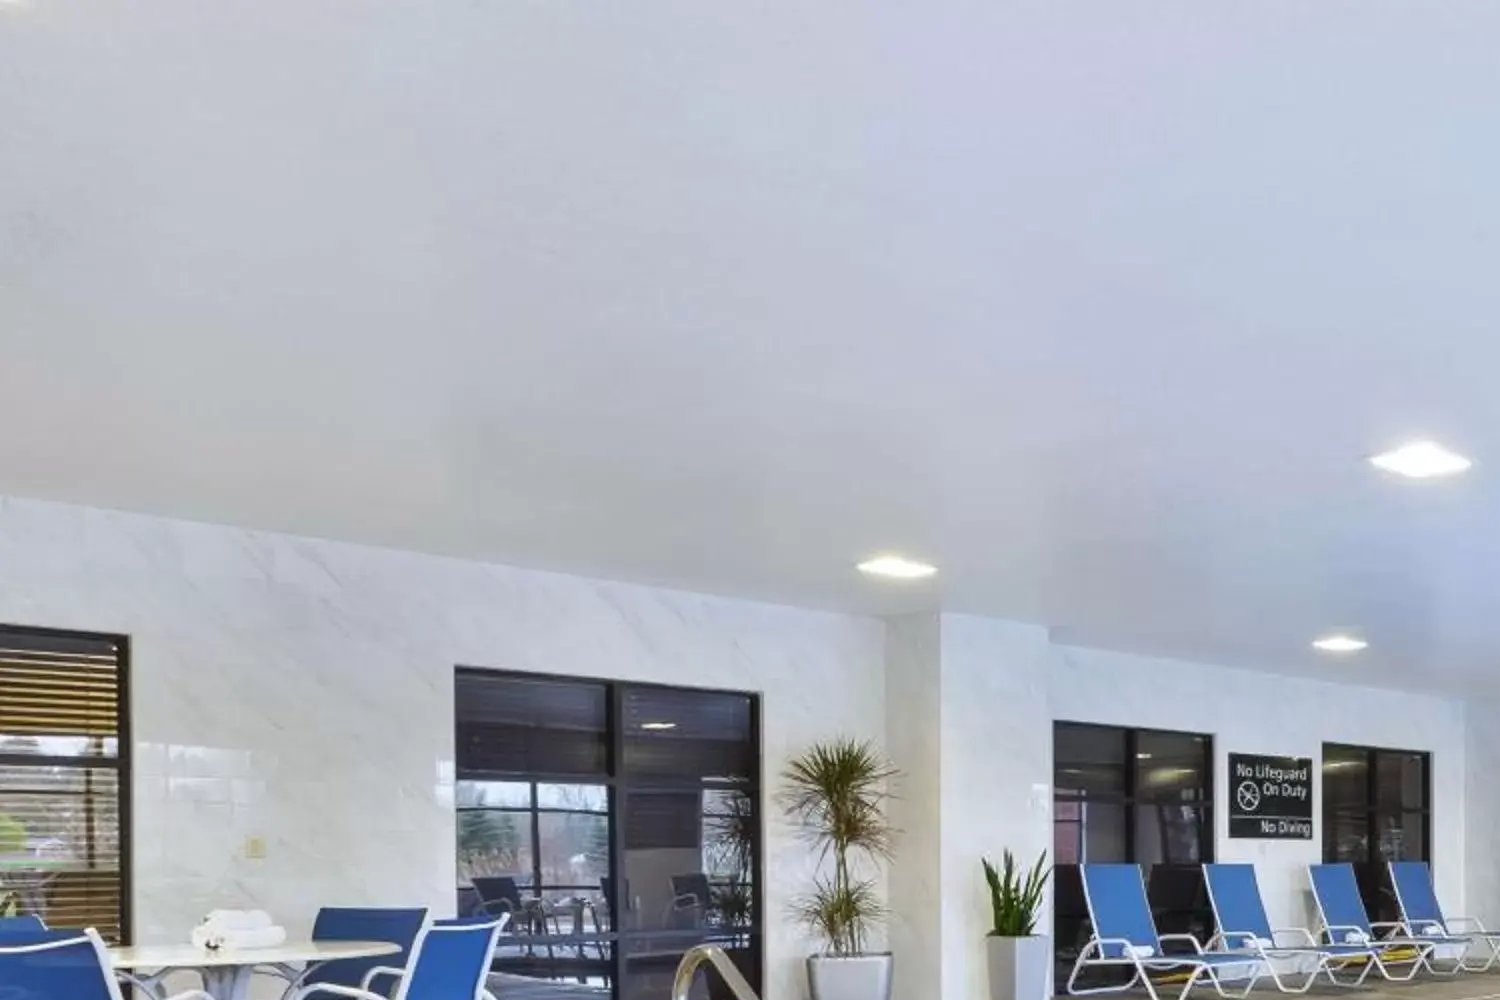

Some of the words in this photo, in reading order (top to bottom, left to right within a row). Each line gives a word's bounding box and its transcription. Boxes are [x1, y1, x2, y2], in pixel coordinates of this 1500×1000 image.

[1237, 764, 1253, 777] No
[1256, 764, 1307, 782] Lifeguard
[1263, 782, 1279, 796] On
[1282, 784, 1307, 800] Duty
[1262, 820, 1277, 833] No
[1280, 820, 1311, 838] Diving
